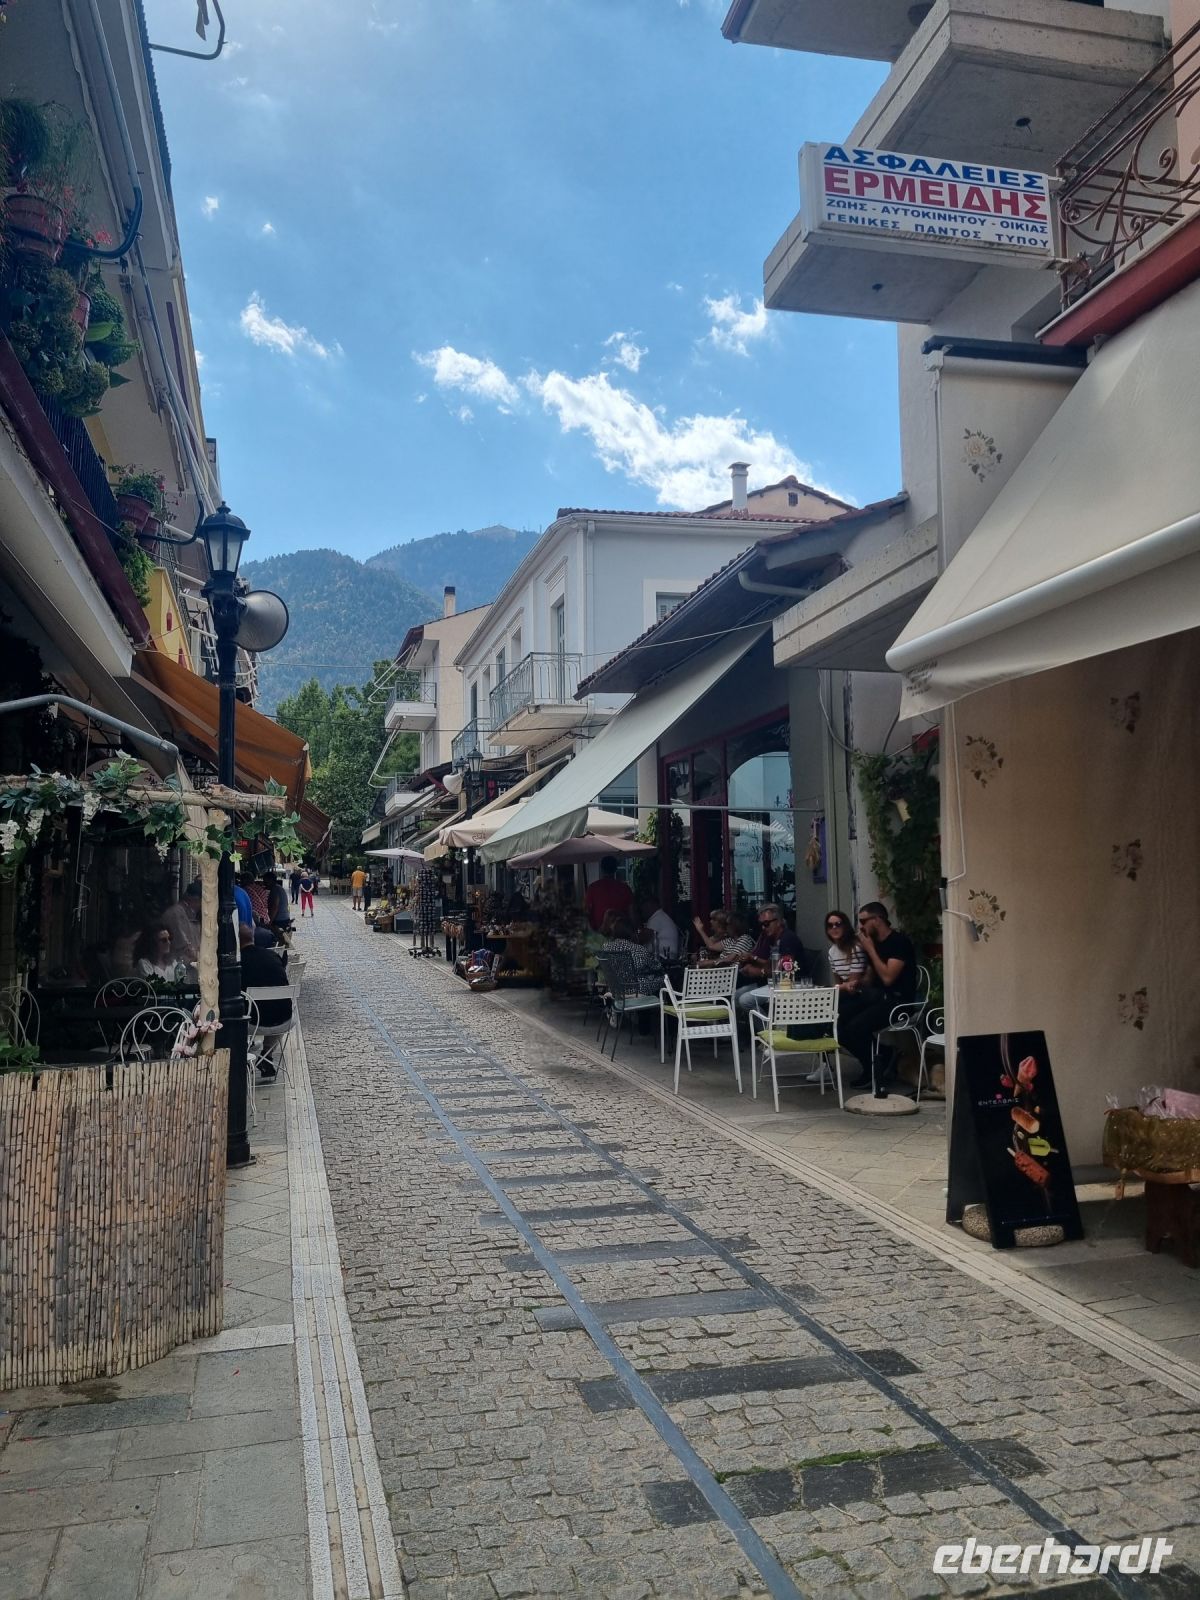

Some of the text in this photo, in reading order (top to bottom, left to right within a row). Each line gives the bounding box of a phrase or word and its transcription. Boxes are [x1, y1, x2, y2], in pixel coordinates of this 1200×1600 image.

[824, 146, 1044, 190] ΑΣΦΑΛΕΙΕΣ
[824, 167, 1048, 220] ΕΡΜΕΙΔΗΣ
[826, 198, 868, 212] ΖΩΗΣ
[881, 205, 987, 226] ΑΥΤΟΚΙΝΗΤΟΥ
[1000, 220, 1048, 234] ΟΙΚΙΑΣ
[827, 213, 1049, 248] ΓΕΝΙΚΕΣ ΠΑΝΤΟΣ ΤΥΠΟΥ
